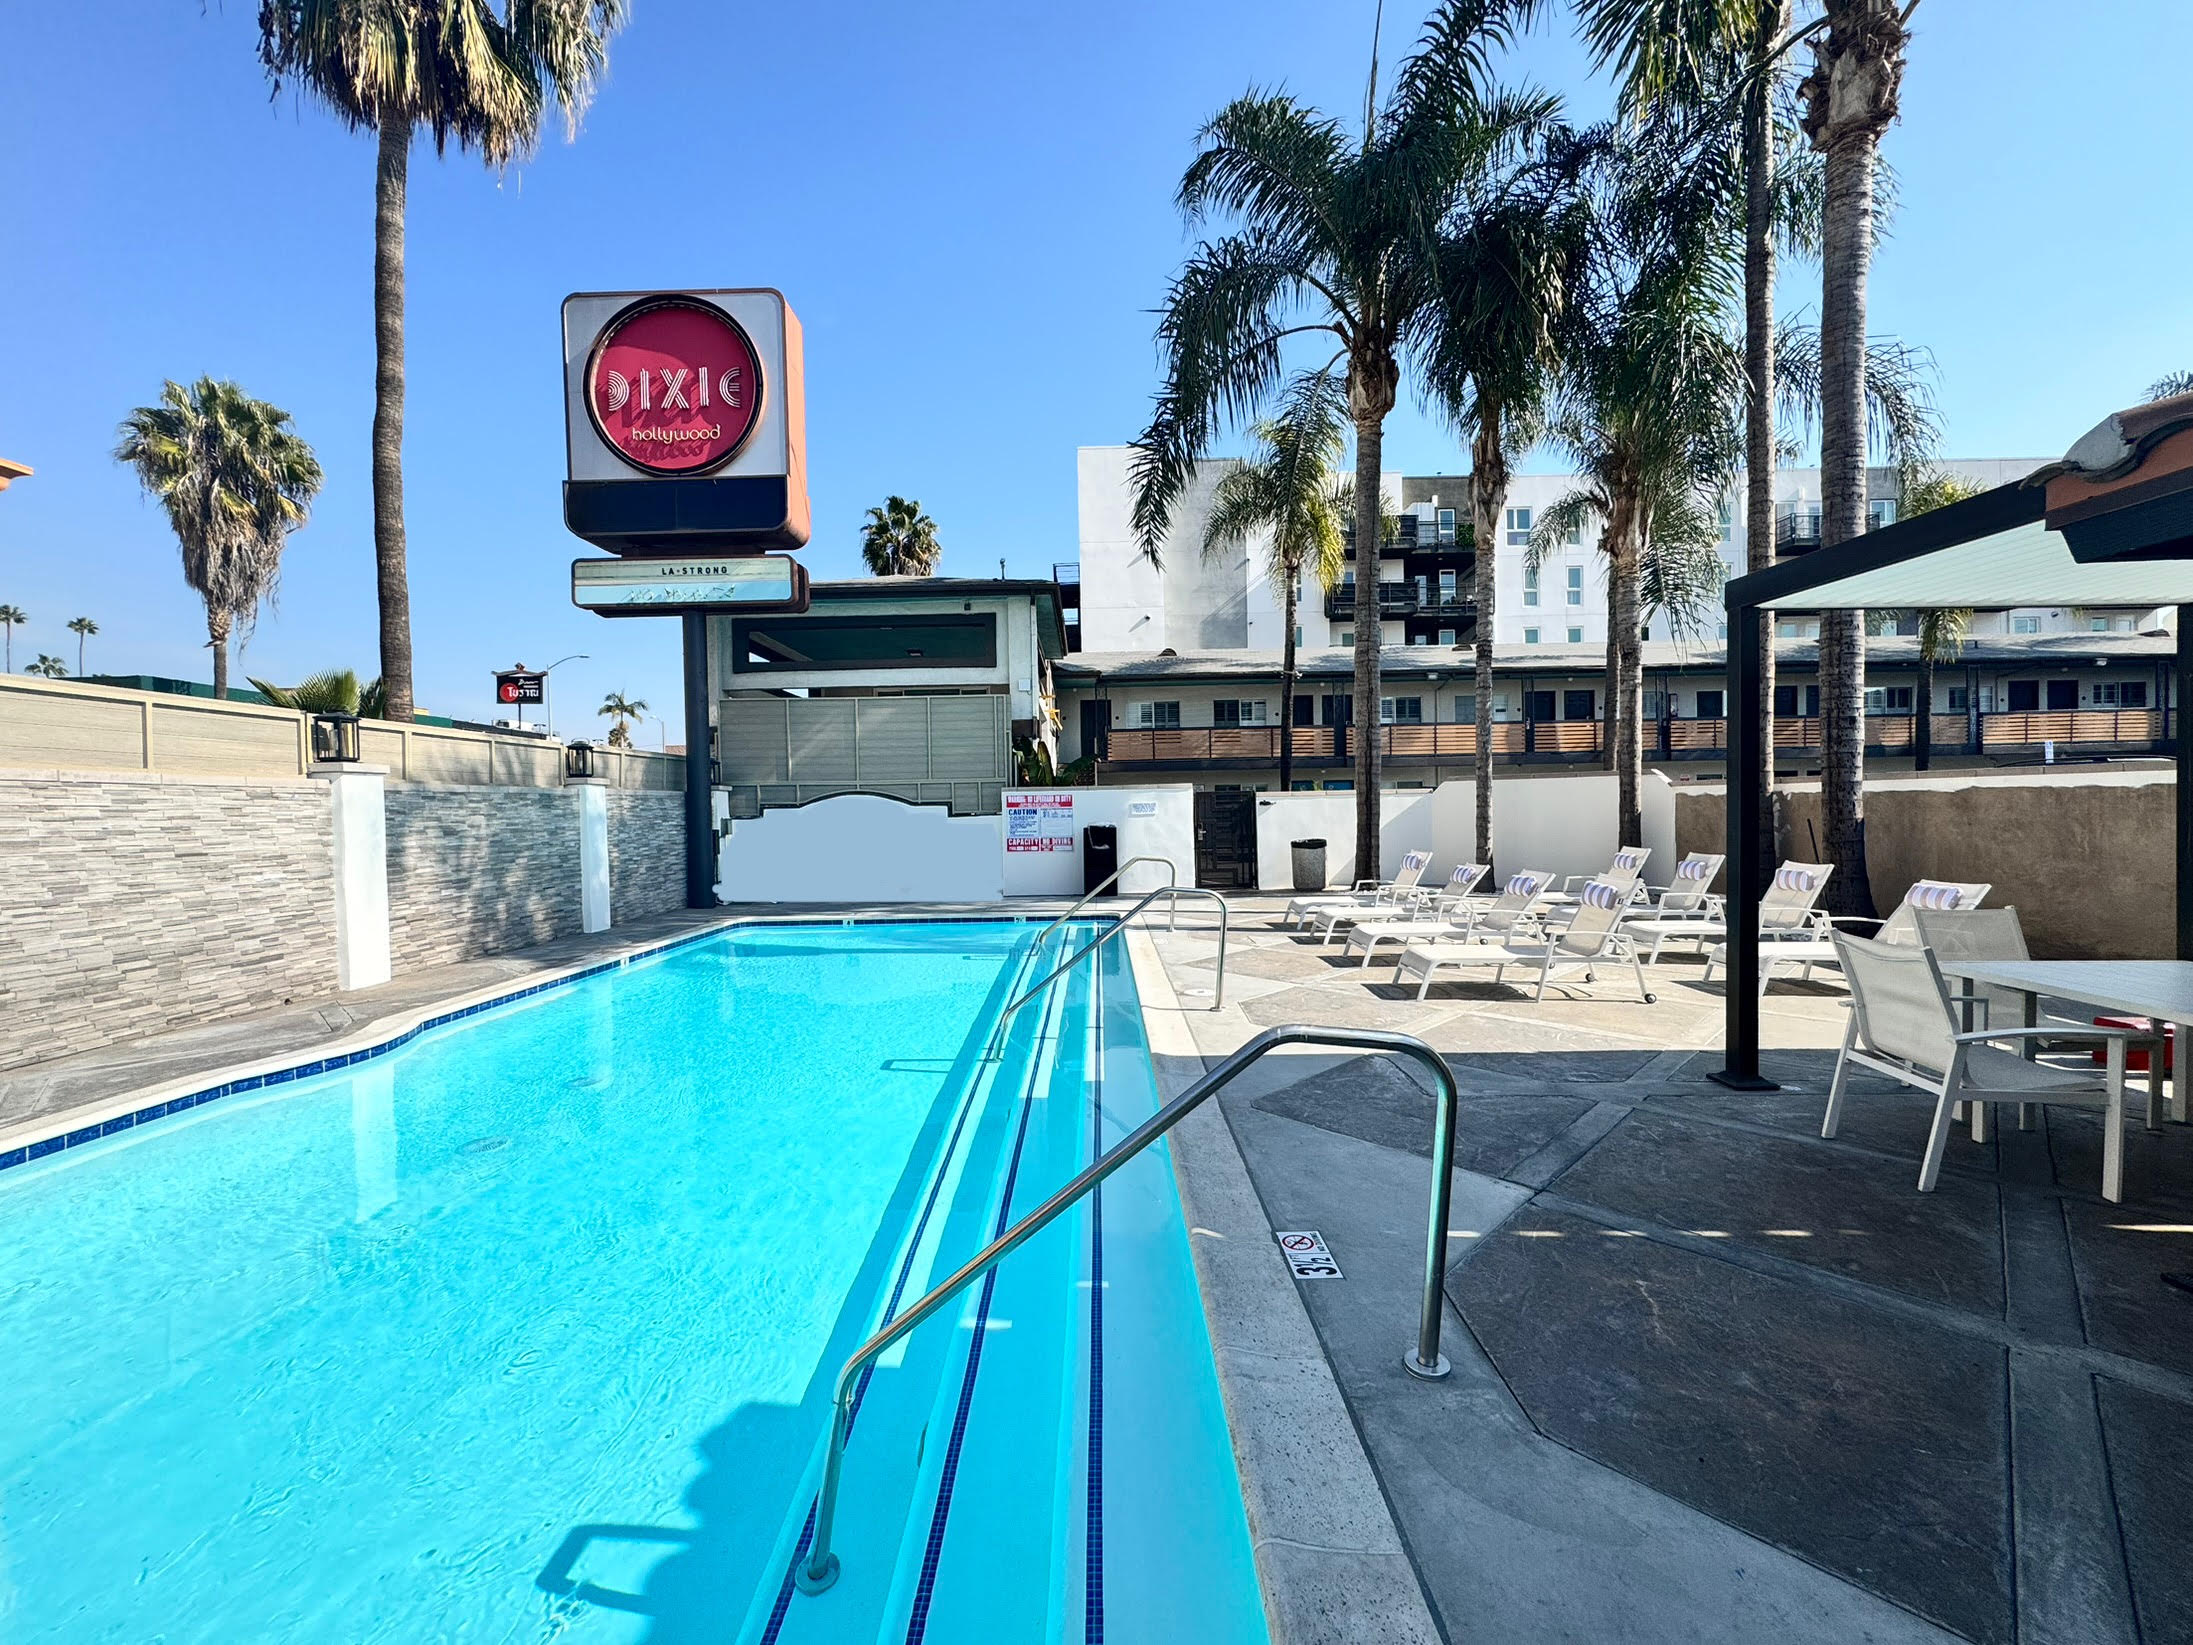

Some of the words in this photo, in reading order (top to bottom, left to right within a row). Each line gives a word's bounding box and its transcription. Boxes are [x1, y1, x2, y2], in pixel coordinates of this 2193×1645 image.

[608, 366, 741, 411] DIXIE
[632, 424, 721, 444] hollywood
[1008, 838, 1039, 846] CAPACITY
